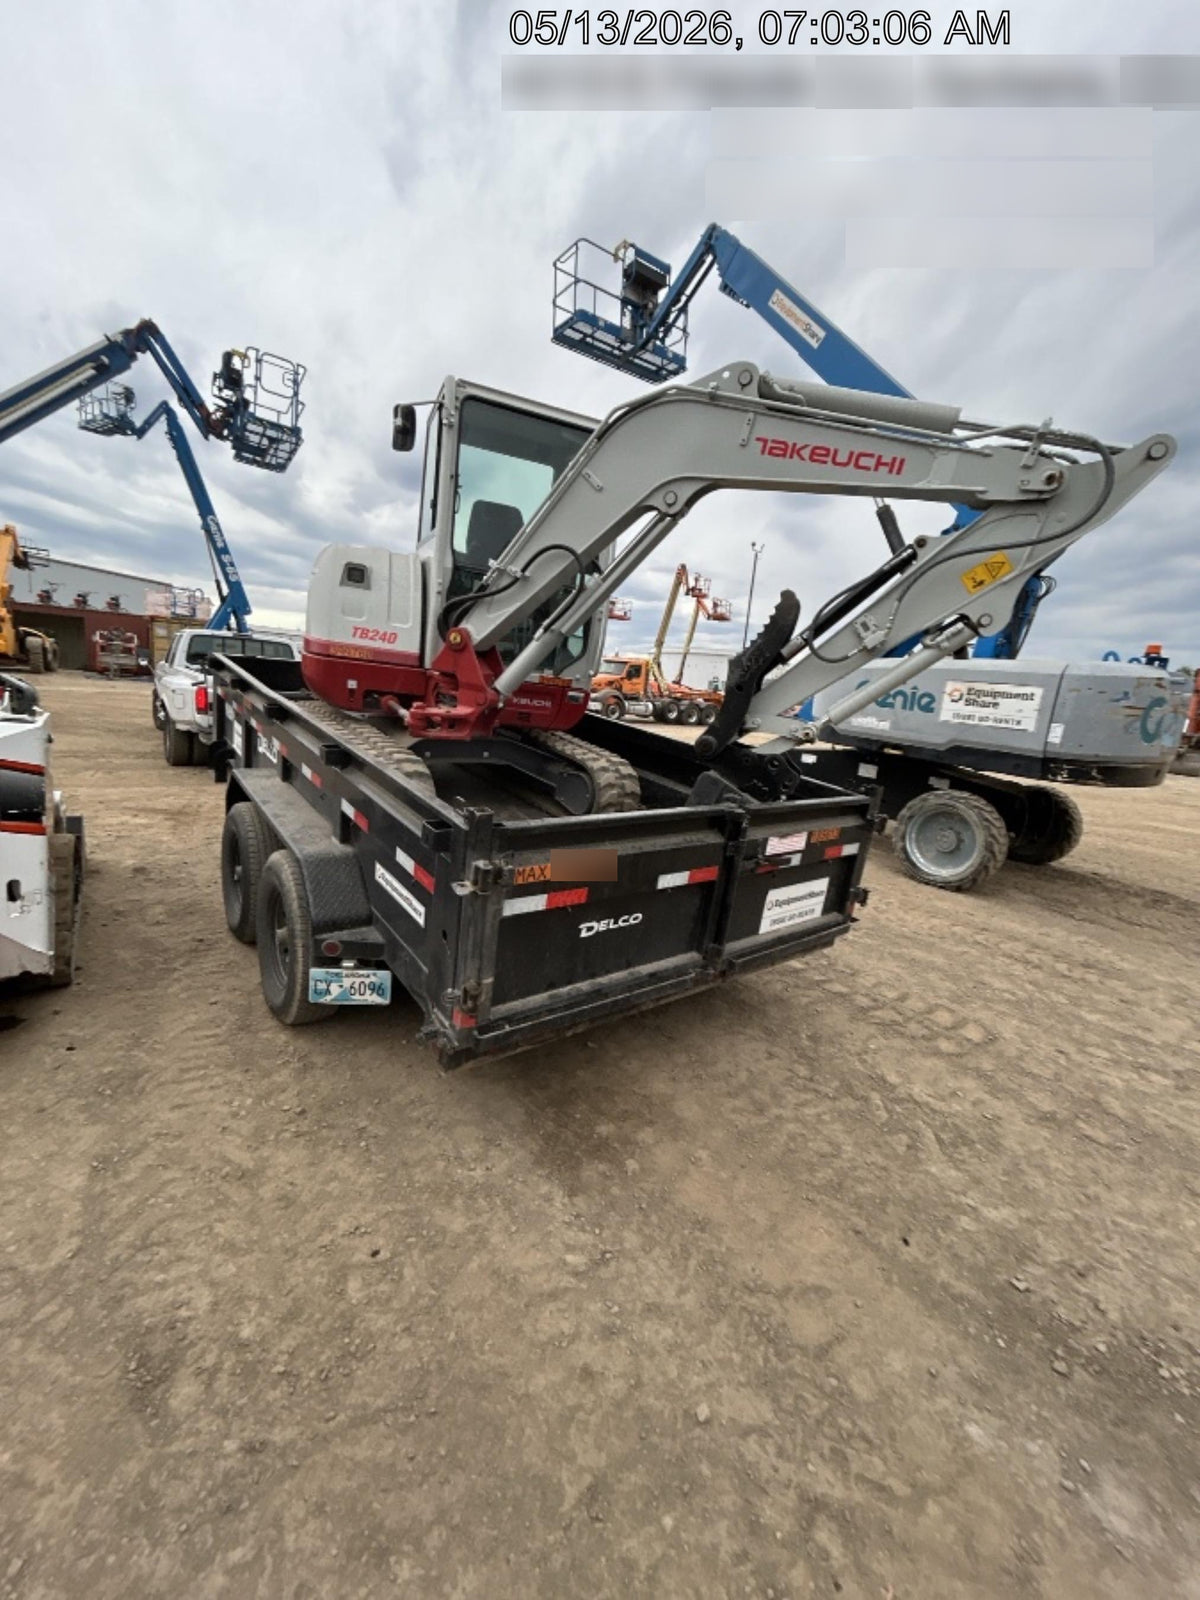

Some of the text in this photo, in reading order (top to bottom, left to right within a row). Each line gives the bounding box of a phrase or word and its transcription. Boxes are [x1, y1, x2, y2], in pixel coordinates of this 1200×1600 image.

[755, 436, 906, 475] TAKEUCHI
[352, 626, 398, 644] TB240
[965, 686, 1037, 702] Equipment
[963, 697, 1001, 710] Share
[515, 865, 548, 882] MAX
[578, 912, 643, 938] DELCO
[349, 980, 385, 997] 6096
